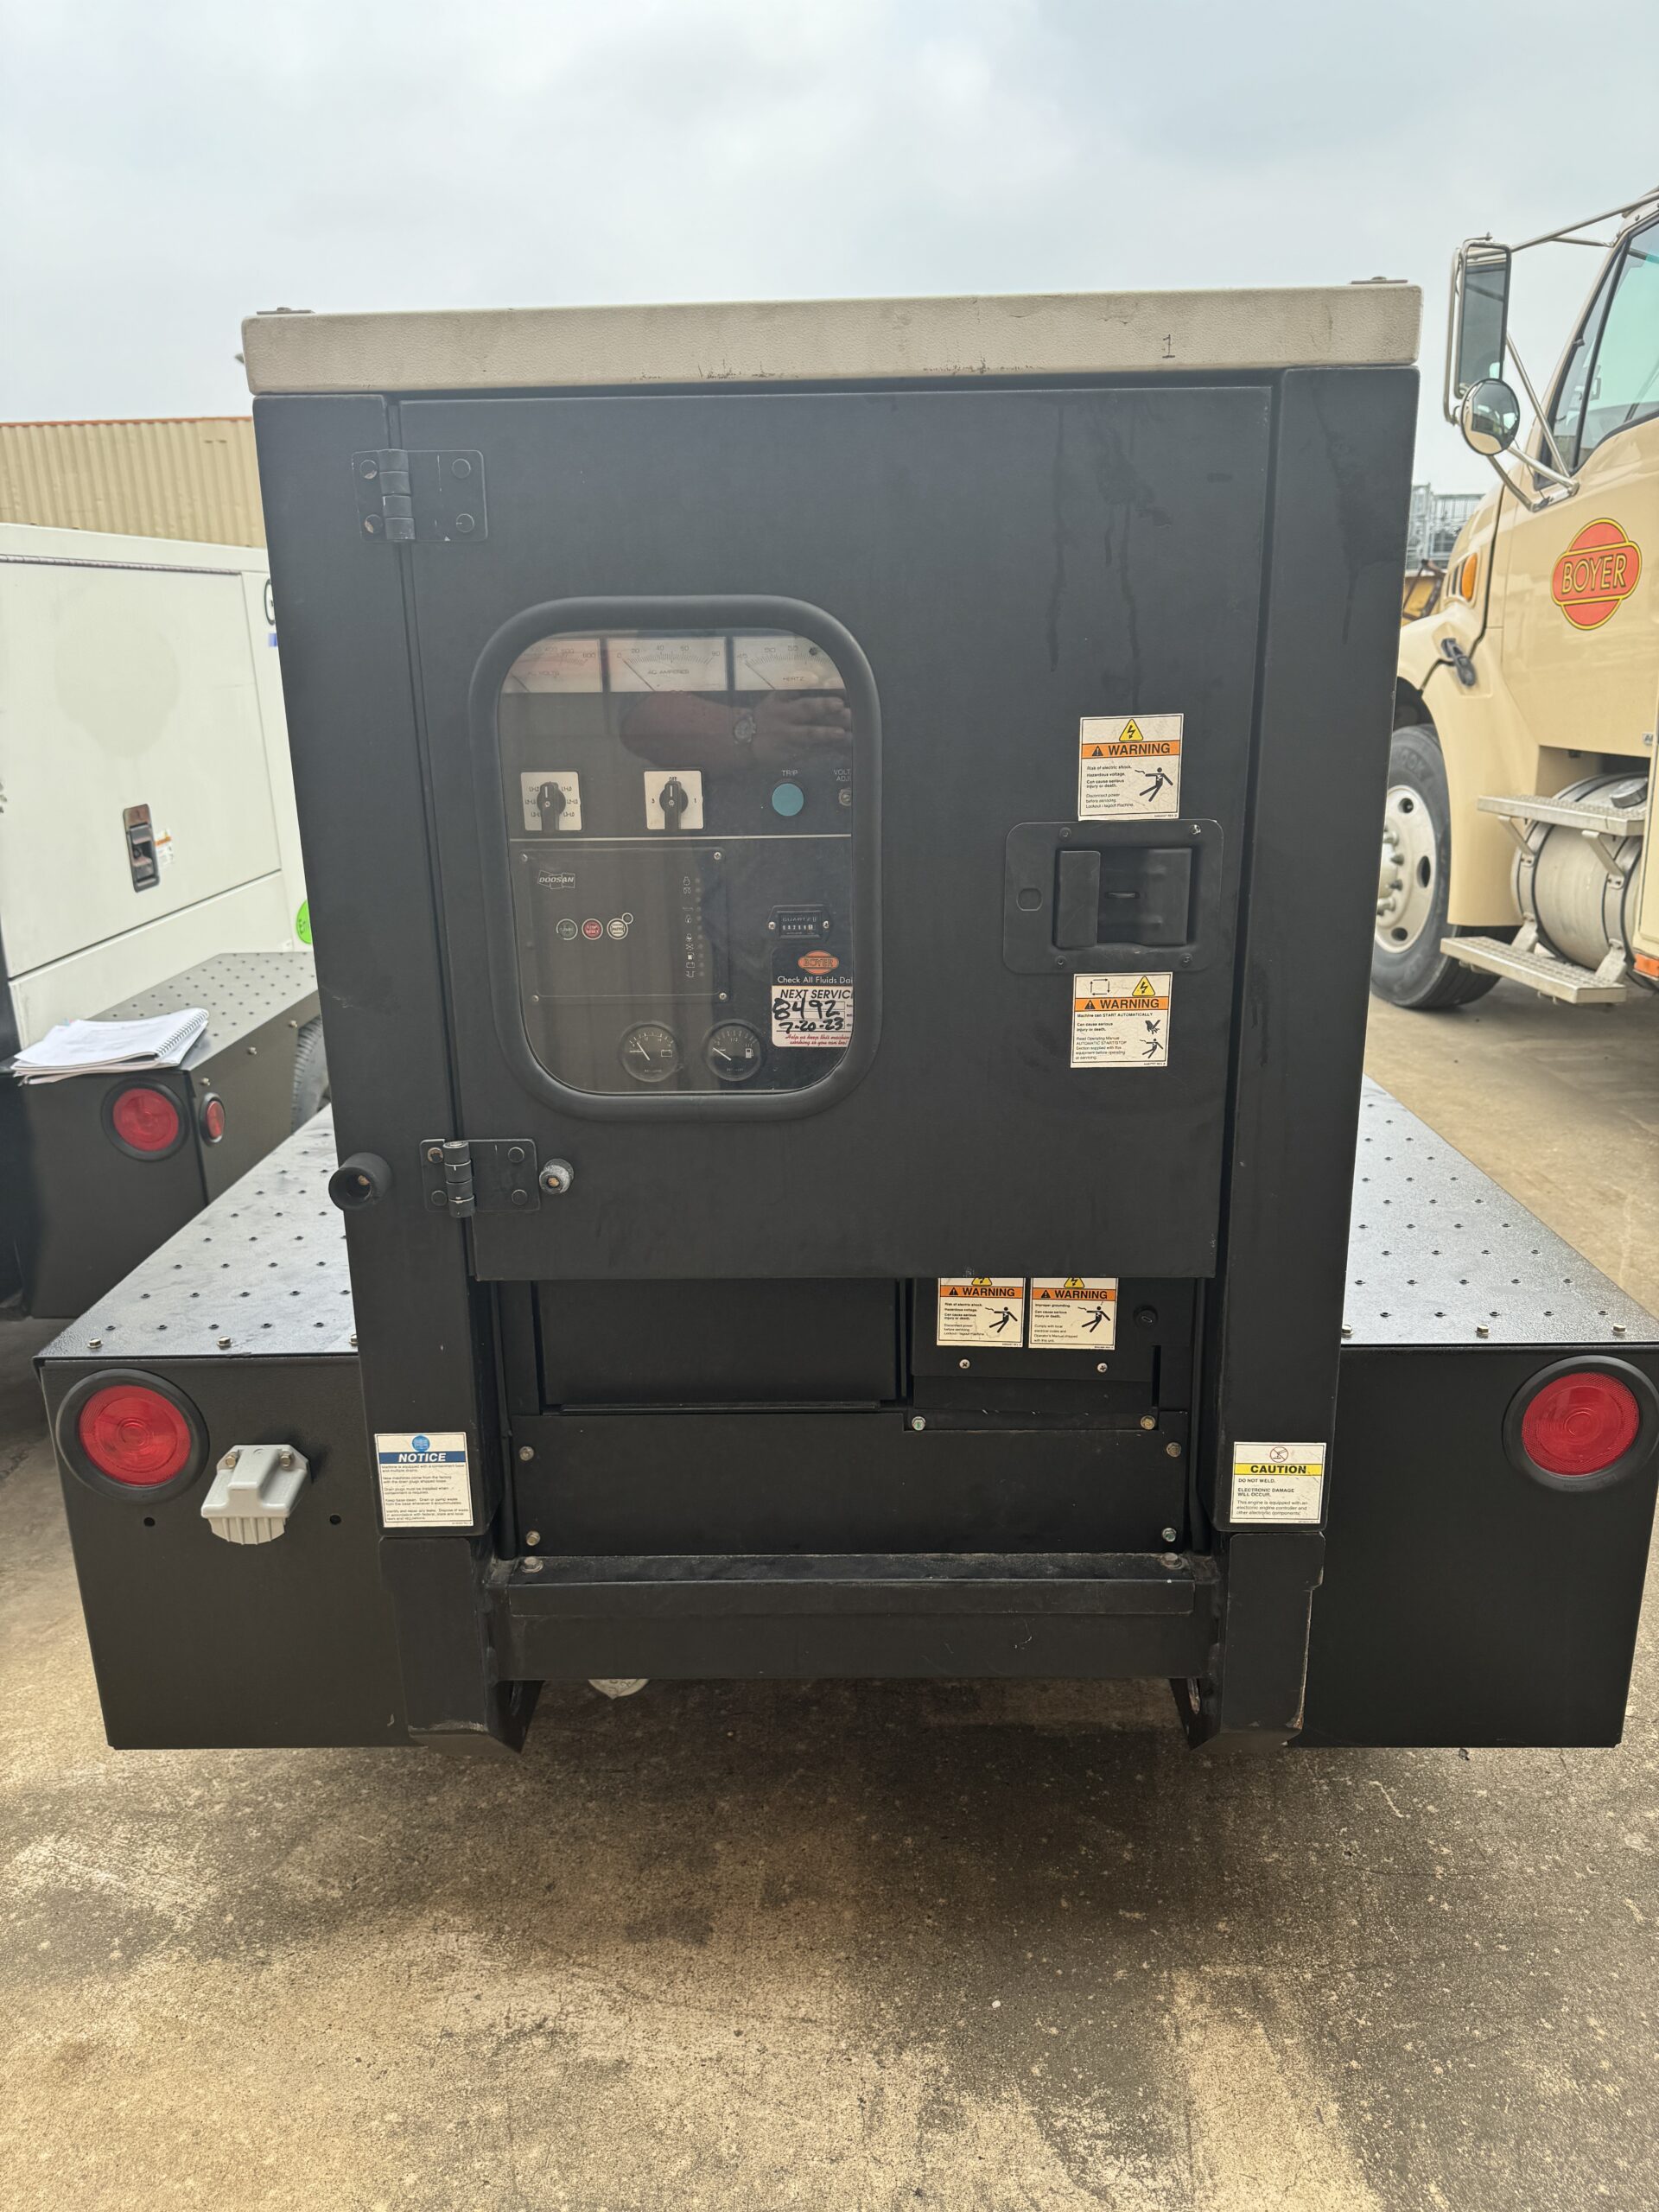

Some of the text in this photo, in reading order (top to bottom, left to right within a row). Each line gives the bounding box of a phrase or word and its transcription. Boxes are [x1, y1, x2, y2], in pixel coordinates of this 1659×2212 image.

[1162, 334, 1175, 359] 1
[1561, 553, 1626, 594] BOYER
[1108, 743, 1171, 755] WARNING
[804, 958, 833, 967] BOYER
[816, 976, 836, 984] Fluids
[780, 989, 854, 999] NEXT SERVIC
[1100, 998, 1160, 1009] WARNING
[963, 1287, 1015, 1297] WARNING
[1054, 1289, 1108, 1300] WARNING
[398, 1452, 447, 1463] NOTICE
[1250, 1465, 1306, 1474] CAUTION
